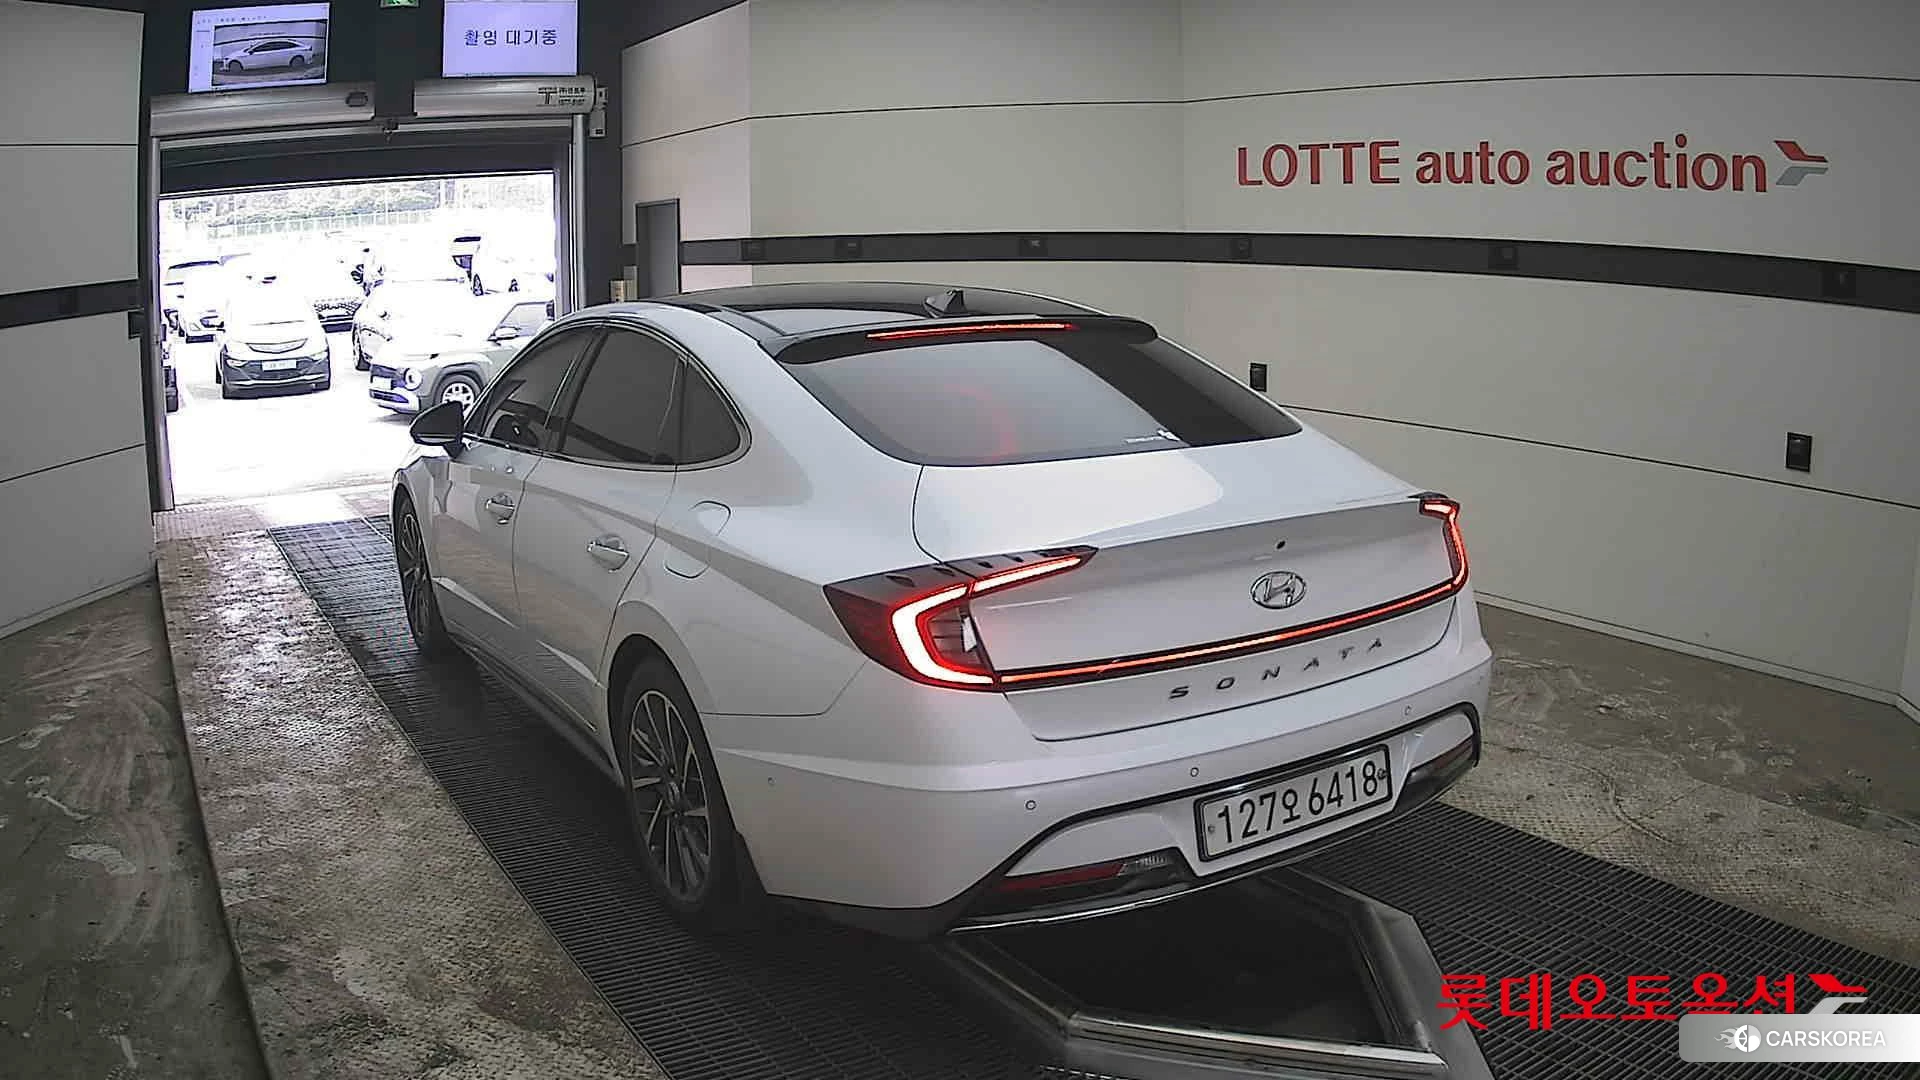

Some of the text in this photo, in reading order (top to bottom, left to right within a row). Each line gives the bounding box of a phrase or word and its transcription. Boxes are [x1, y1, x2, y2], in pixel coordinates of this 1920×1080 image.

[506, 29, 558, 47] 대기중
[1237, 133, 1767, 193] LOTTE auto auction
[1168, 637, 1383, 700] SONATA
